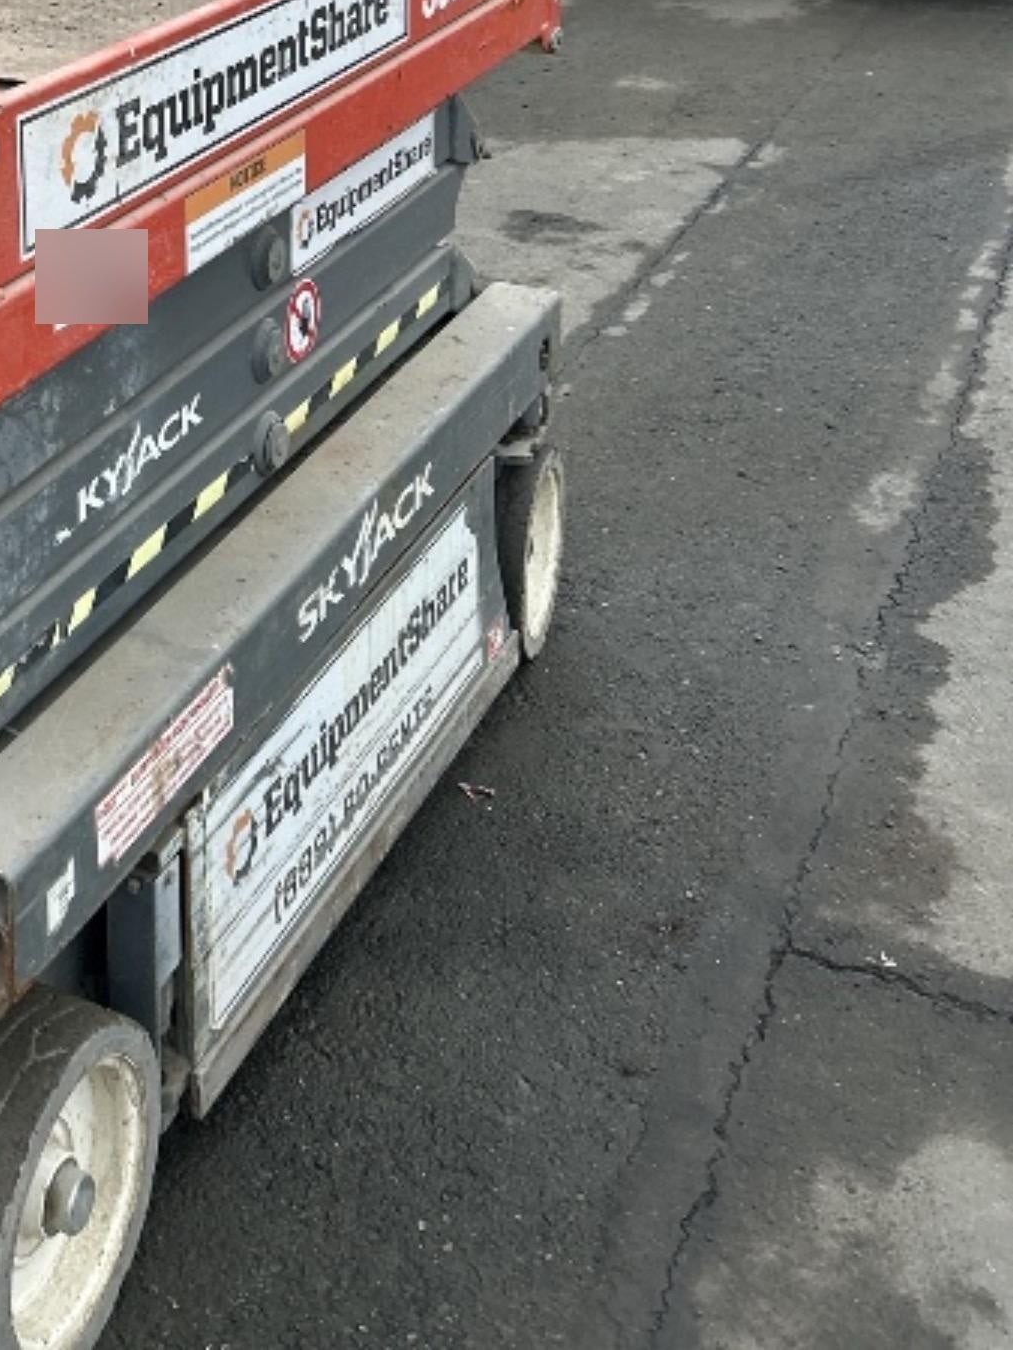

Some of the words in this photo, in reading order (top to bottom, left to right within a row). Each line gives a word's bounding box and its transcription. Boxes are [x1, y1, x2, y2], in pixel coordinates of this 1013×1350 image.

[55, 392, 204, 544] KYJACK
[298, 461, 436, 644] SKYJACK
[263, 557, 469, 837] EquipmentShare
